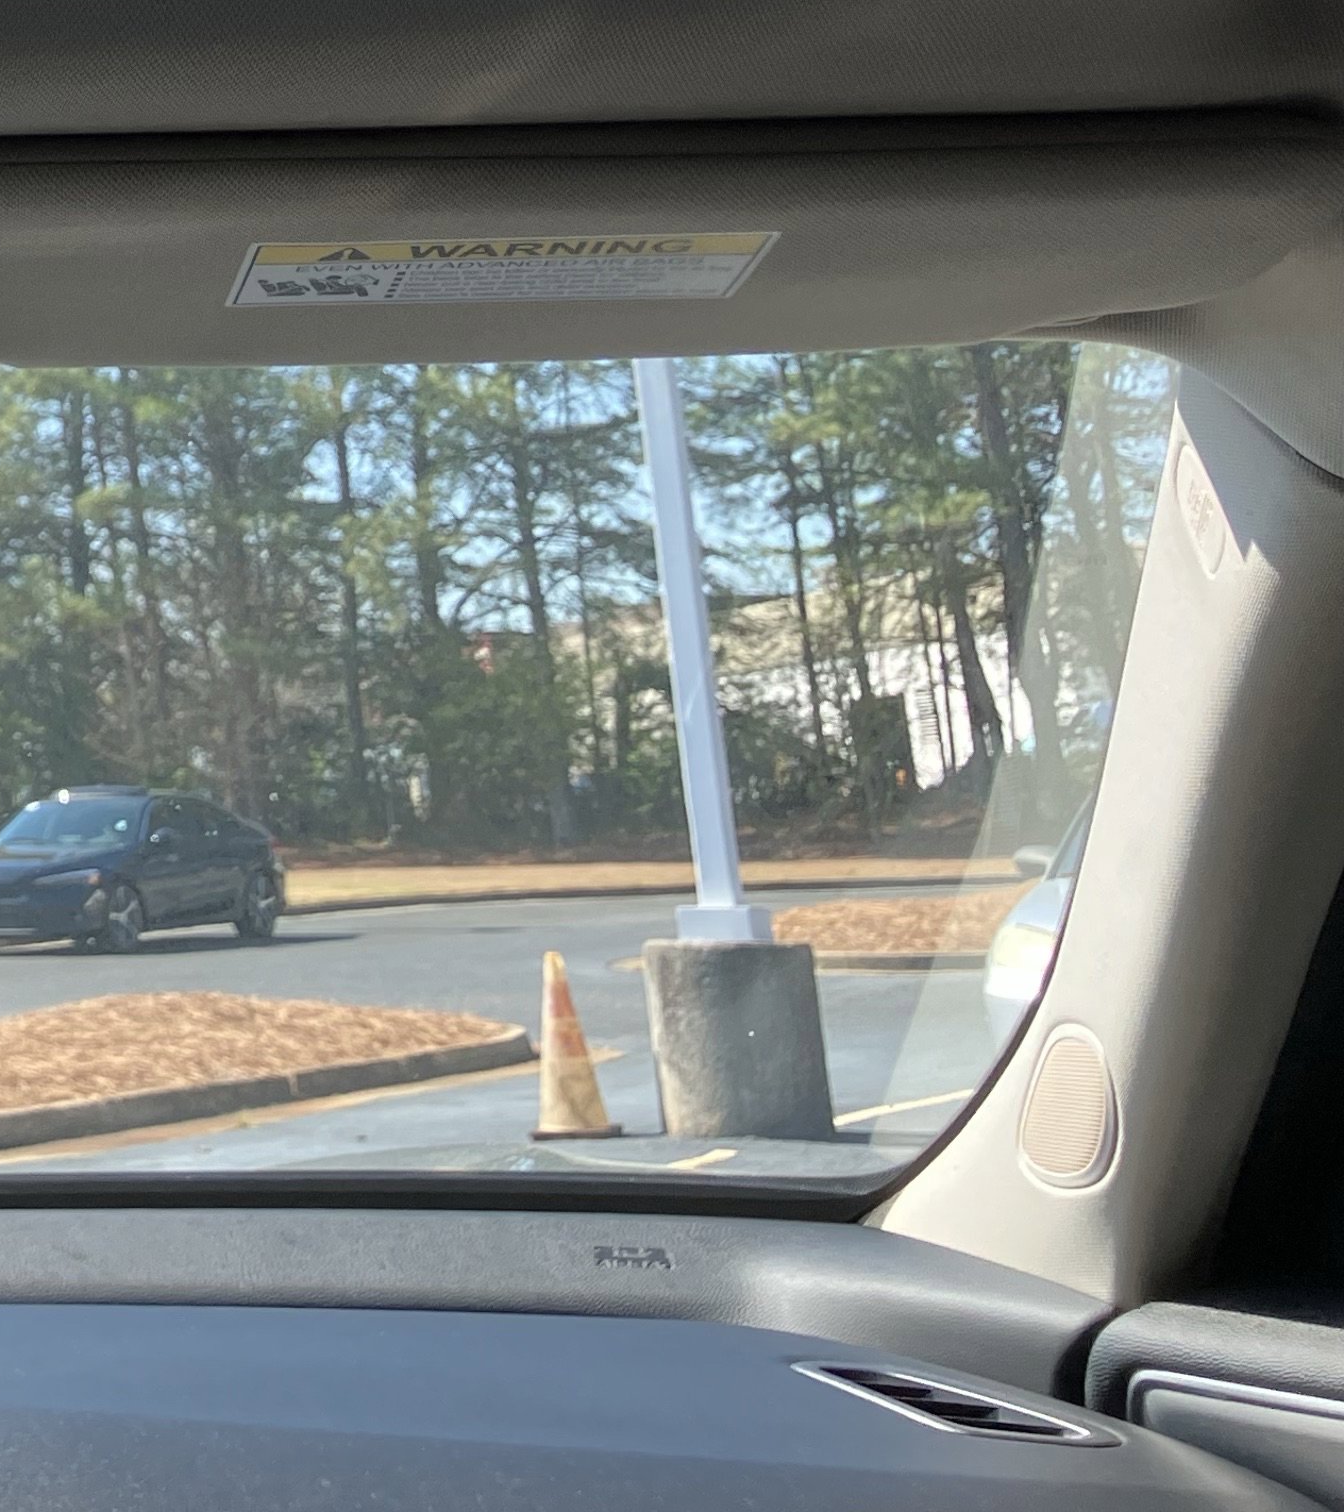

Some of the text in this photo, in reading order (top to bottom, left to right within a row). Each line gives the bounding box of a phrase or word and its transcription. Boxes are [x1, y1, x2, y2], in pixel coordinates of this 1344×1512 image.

[409, 238, 695, 259] WARNING
[296, 263, 363, 273] EVEN
[371, 261, 434, 272] WITH
